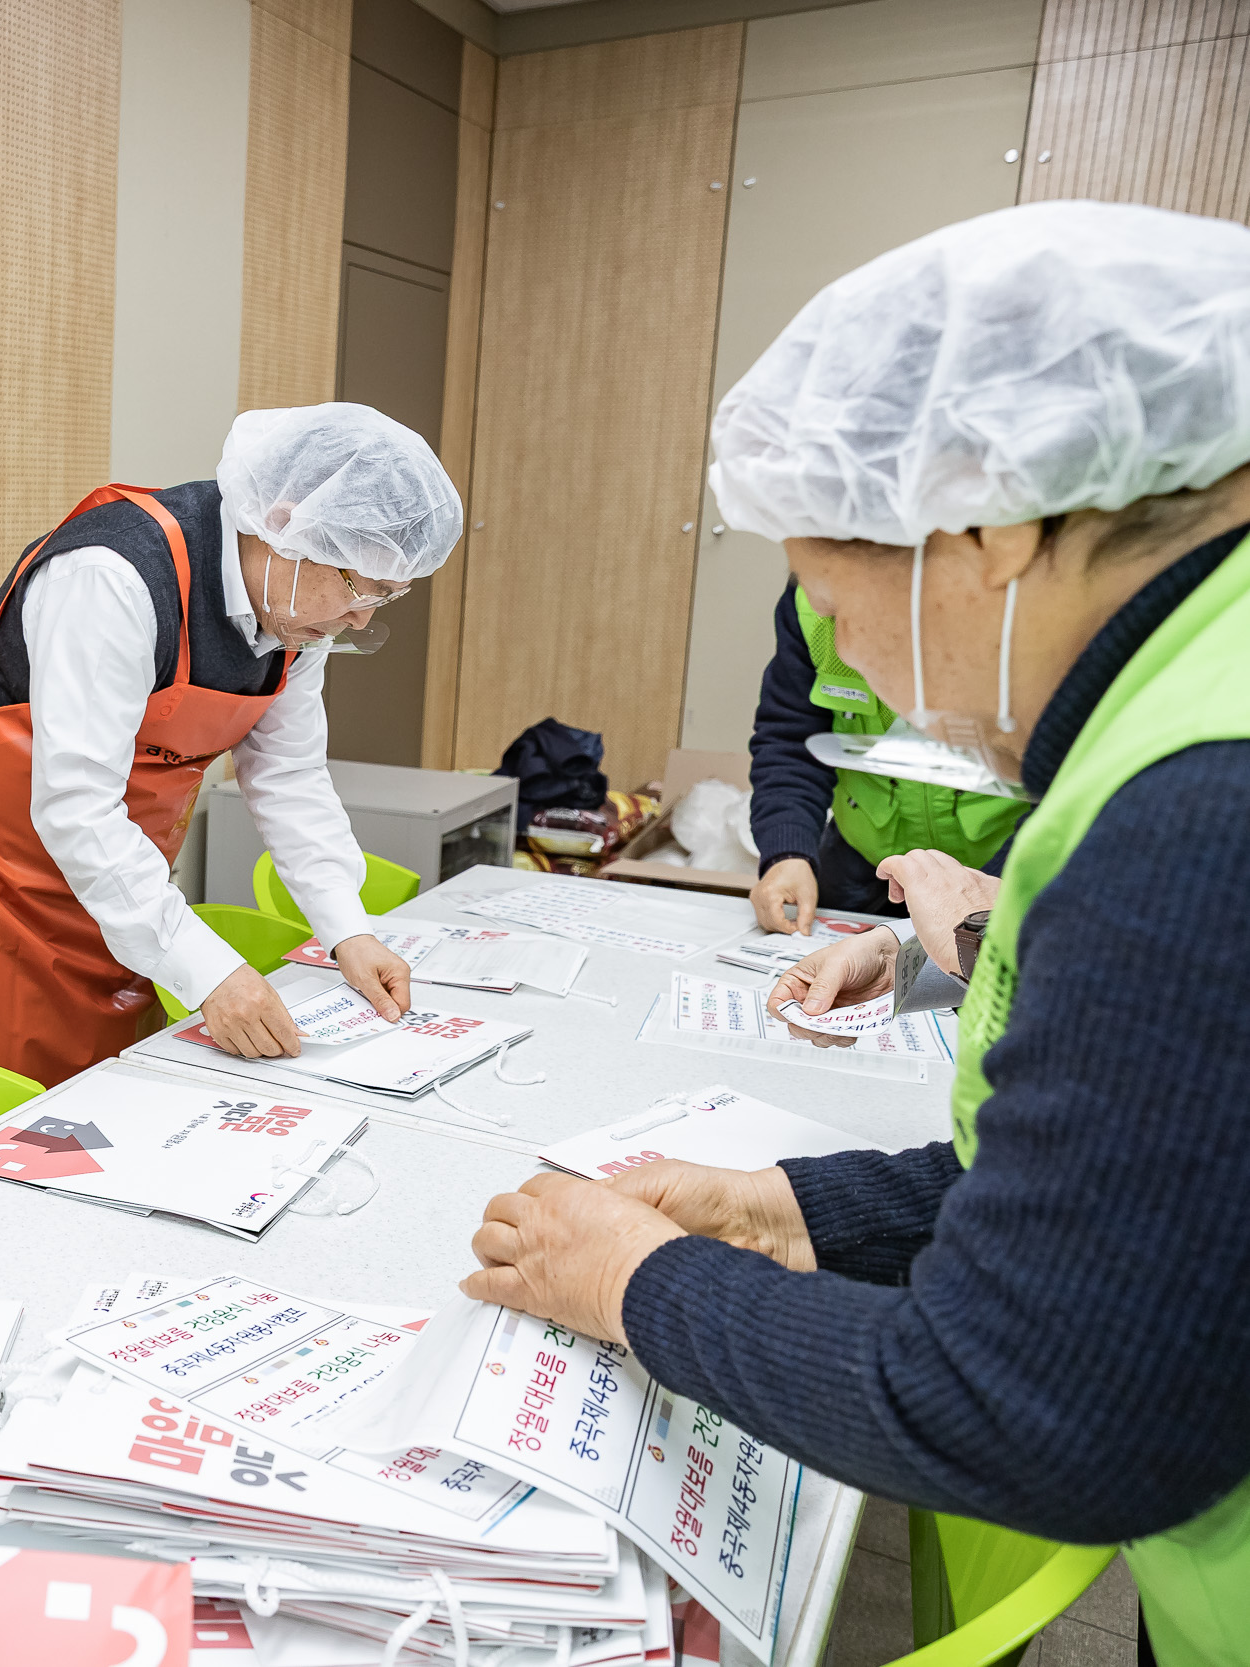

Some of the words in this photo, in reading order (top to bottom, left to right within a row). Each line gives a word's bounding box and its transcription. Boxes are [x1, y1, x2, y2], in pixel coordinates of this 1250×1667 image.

[401, 1017, 486, 1040] 마음을
[212, 1100, 259, 1124] 잇다
[217, 1105, 313, 1137] 마음을
[108, 1326, 195, 1364] 정월대보름
[183, 1303, 252, 1333] 건강음식
[240, 1291, 279, 1307] 나눔
[160, 1306, 308, 1378] 중곡제4동자원봉사캠프
[234, 1378, 321, 1424] 정월대보름
[306, 1346, 376, 1383] 건강음식
[361, 1331, 402, 1349] 나눔
[507, 1350, 568, 1452] 정월대보름
[670, 1445, 714, 1557] 정월대보름
